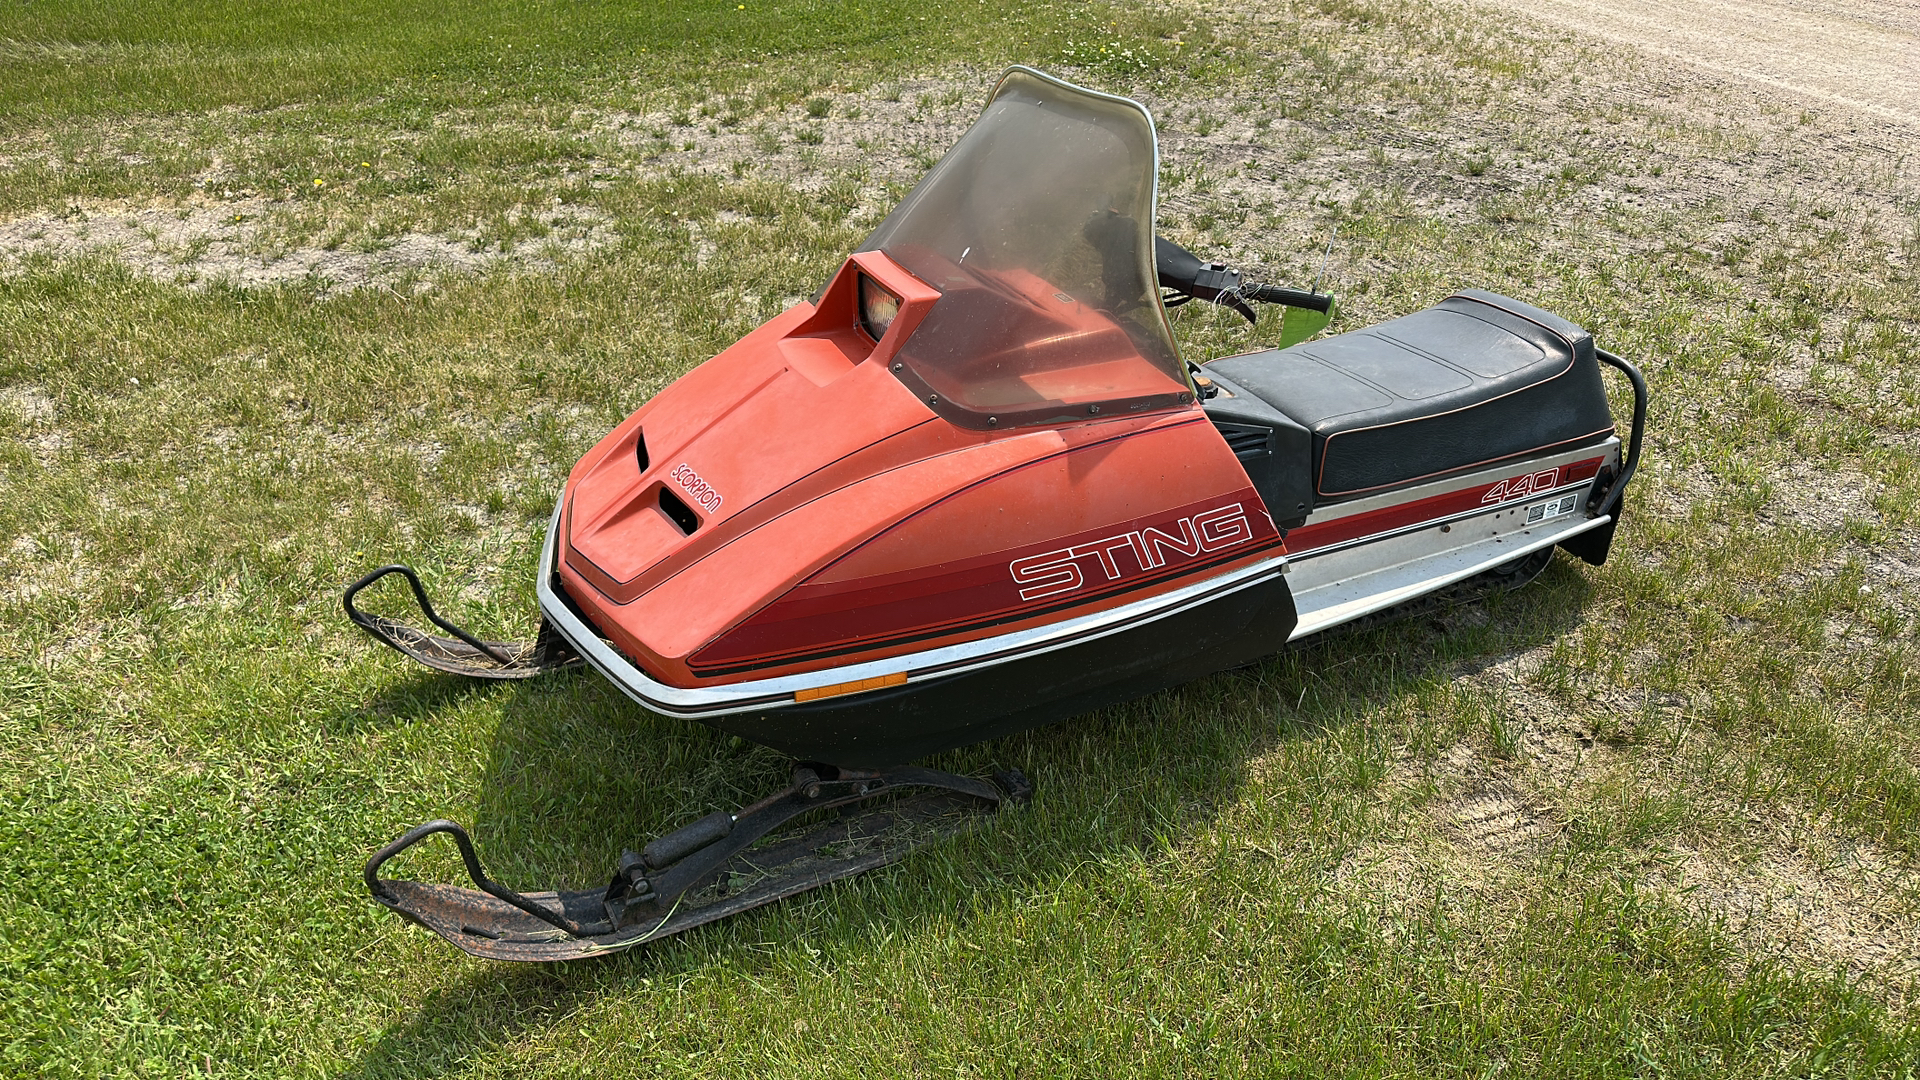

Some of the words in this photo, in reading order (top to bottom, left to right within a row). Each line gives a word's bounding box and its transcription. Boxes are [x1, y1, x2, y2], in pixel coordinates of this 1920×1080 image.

[671, 462, 723, 514] SCORPION
[1481, 467, 1559, 503] 440
[1009, 502, 1253, 601] STING
